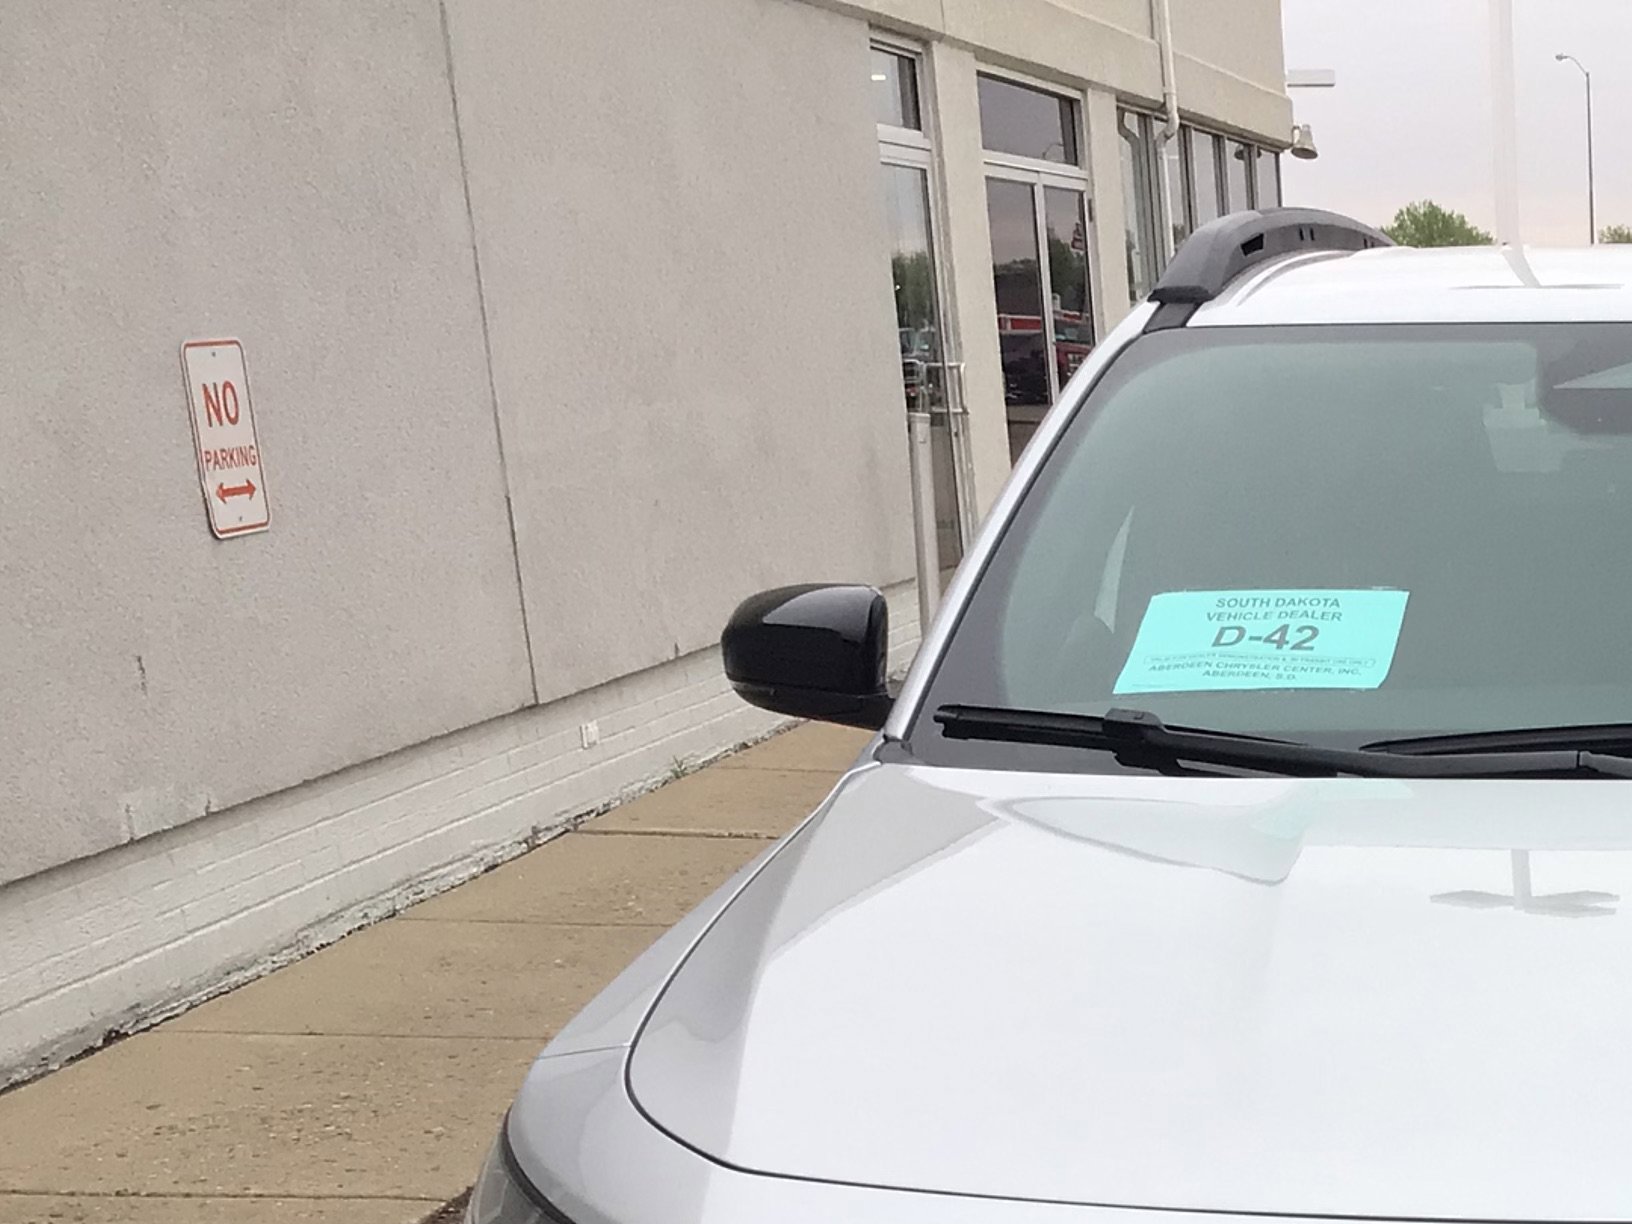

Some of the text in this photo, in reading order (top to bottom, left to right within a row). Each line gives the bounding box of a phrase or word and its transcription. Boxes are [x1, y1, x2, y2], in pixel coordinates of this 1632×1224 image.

[202, 380, 239, 427] NO
[204, 446, 256, 471] PARKING
[1216, 598, 1340, 608] SOUTH DAKOTA
[1207, 610, 1343, 621] VEHICLE DEALER
[1211, 624, 1319, 651] D-42
[1148, 661, 1213, 671] ABERDEEN
[1216, 662, 1280, 671] CHRYSLER
